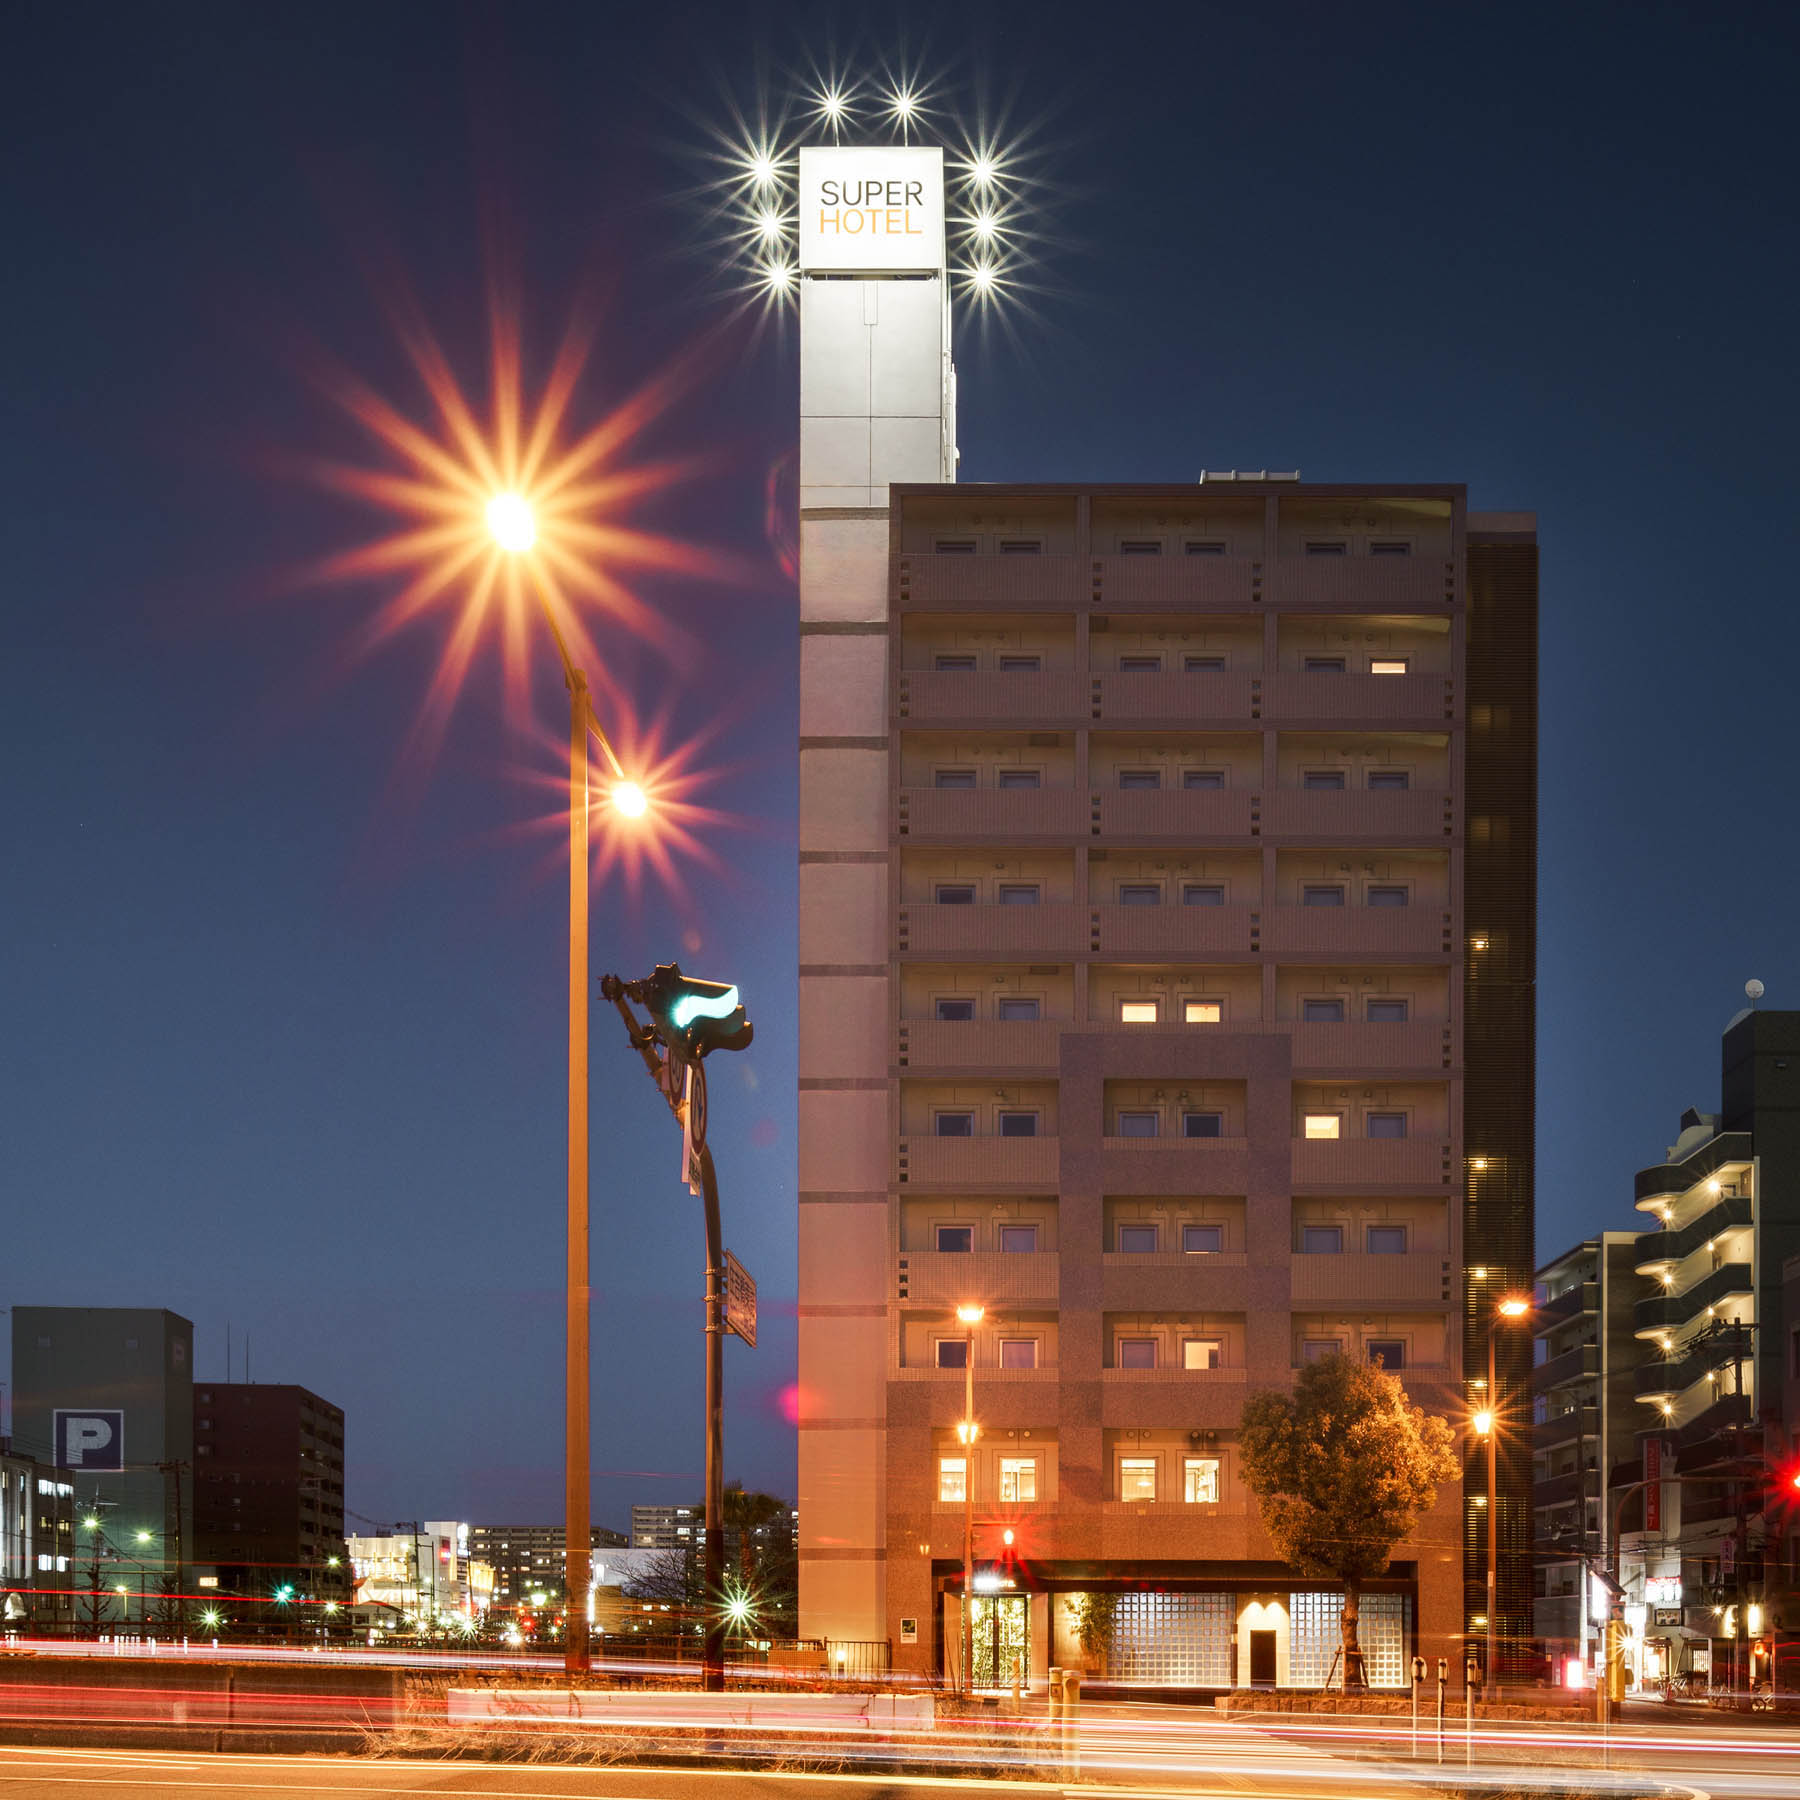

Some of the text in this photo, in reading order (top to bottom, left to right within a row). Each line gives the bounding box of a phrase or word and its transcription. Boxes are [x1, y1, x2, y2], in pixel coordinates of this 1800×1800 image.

[821, 180, 924, 206] SUPER
[820, 208, 923, 234] HOTEL
[66, 1418, 113, 1465] P
